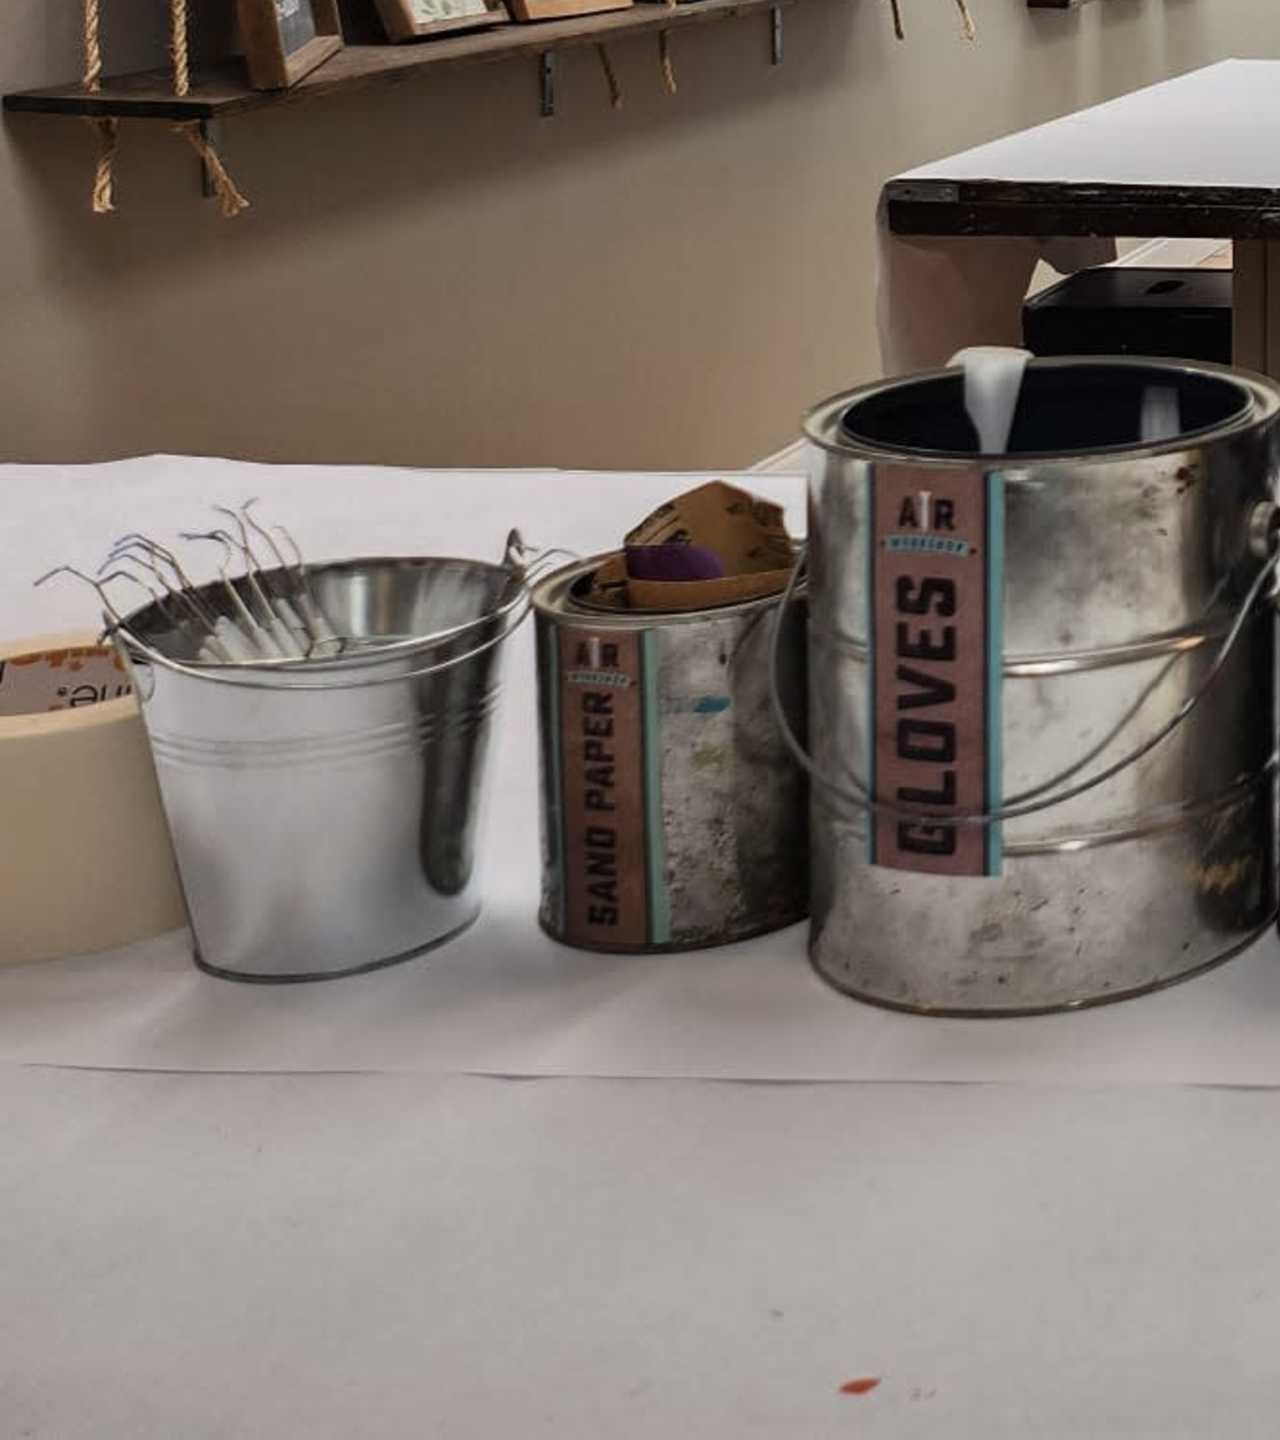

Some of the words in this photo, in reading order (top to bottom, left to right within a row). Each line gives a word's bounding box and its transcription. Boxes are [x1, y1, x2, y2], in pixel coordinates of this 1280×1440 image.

[582, 691, 616, 812] PAPER
[895, 574, 958, 856] GLOVES
[584, 826, 618, 928] SAND
